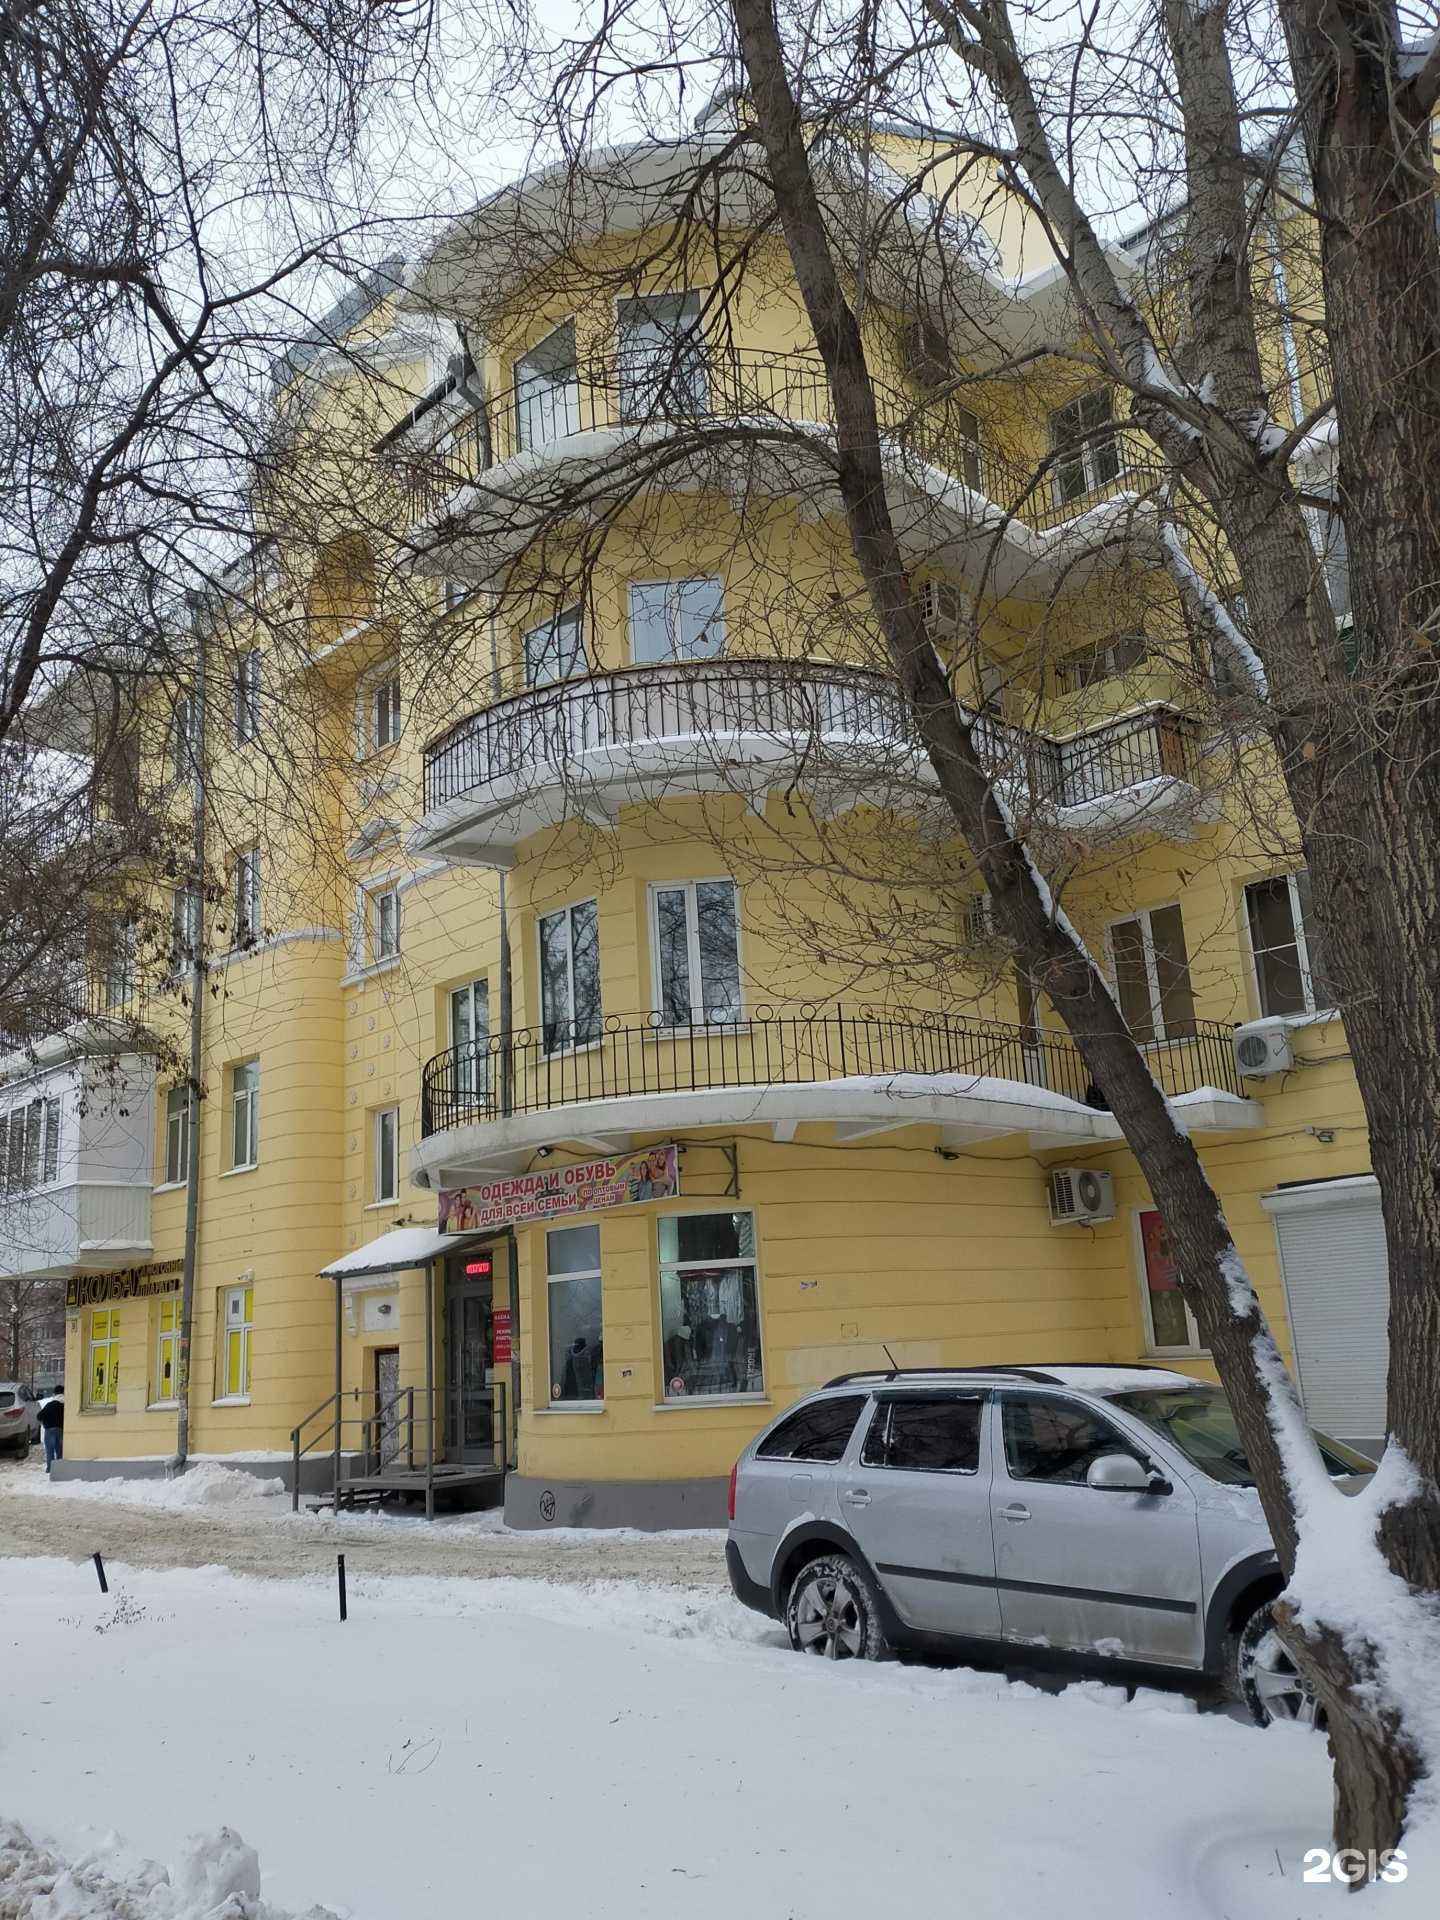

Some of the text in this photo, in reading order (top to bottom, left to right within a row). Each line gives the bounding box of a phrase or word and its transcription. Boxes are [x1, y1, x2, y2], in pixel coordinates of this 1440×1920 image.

[481, 1162, 617, 1201] ОДЕЖДА И ОБУВЬ
[480, 1208, 504, 1222] ДЛЯ
[536, 1193, 577, 1211] СЕМЬИ
[79, 1268, 139, 1306] КОЛБА
